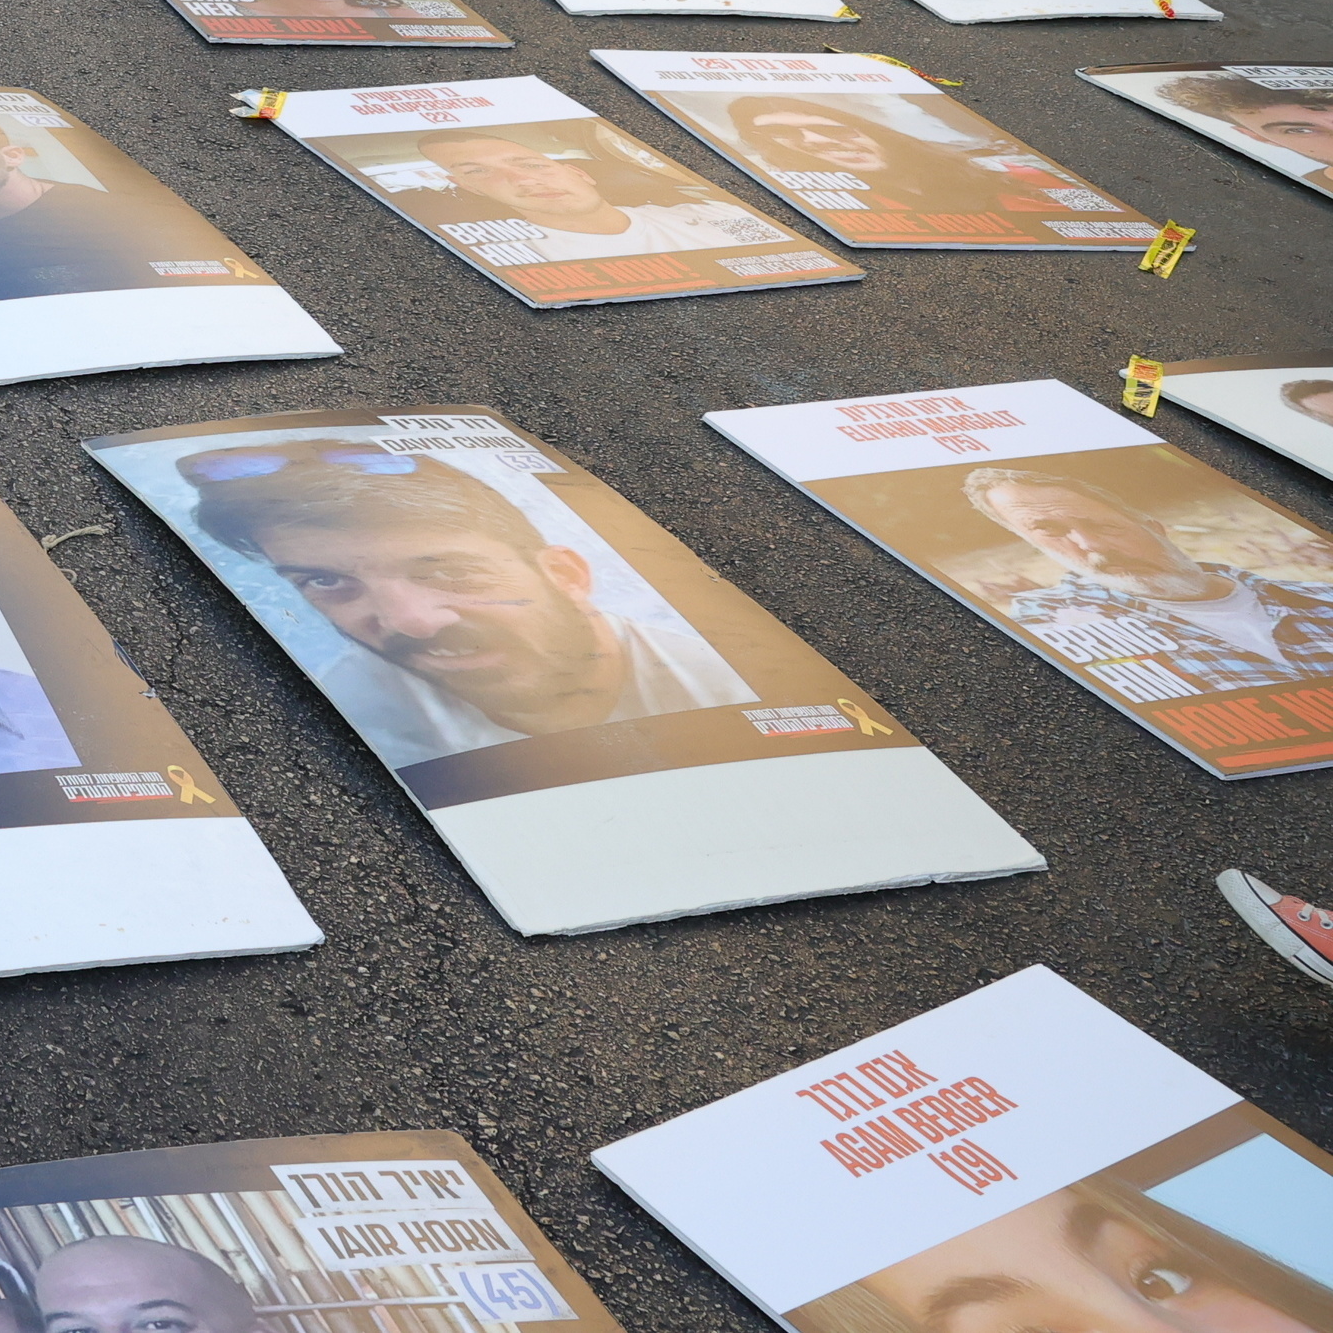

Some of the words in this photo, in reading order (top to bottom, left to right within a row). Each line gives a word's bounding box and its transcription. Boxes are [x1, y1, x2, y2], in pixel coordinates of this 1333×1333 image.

[186, 2, 243, 17] HER
[200, 18, 286, 34] HOME
[288, 17, 365, 35] NOW!
[433, 87, 462, 97] בר
[350, 102, 387, 116] BAR
[384, 96, 496, 114] KUPERSHTEIN
[418, 111, 462, 124] (22)
[769, 170, 871, 190] BRING
[793, 191, 871, 210] HIM
[437, 218, 549, 245] BRING
[469, 242, 550, 267] HIM
[506, 263, 611, 292] HOME
[595, 253, 701, 284] NOW!
[834, 401, 904, 423] מרגלית
[904, 395, 976, 417] אליהו
[389, 418, 455, 432] קוניו
[462, 417, 499, 430] דוד
[835, 420, 929, 443] ELIYAHU
[917, 409, 1027, 435] MARGALIT
[381, 436, 455, 452] DAVID
[451, 434, 526, 452] CUNIO
[931, 432, 992, 455] (75)
[494, 453, 557, 472] (33)
[1025, 616, 1181, 664] BRING
[1083, 657, 1205, 705] HIM
[1151, 696, 1310, 751] HOME
[855, 1049, 939, 1104] אגם
[795, 1072, 879, 1122] ברגר
[819, 1115, 925, 1179] AGAM
[892, 1076, 1020, 1145] BERGER
[926, 1137, 1020, 1196] (19)
[287, 1171, 384, 1209] הורן
[378, 1169, 465, 1200] יאיר
[317, 1221, 406, 1260] IAIR
[399, 1218, 511, 1254] HORN
[459, 1268, 560, 1319] (45)
